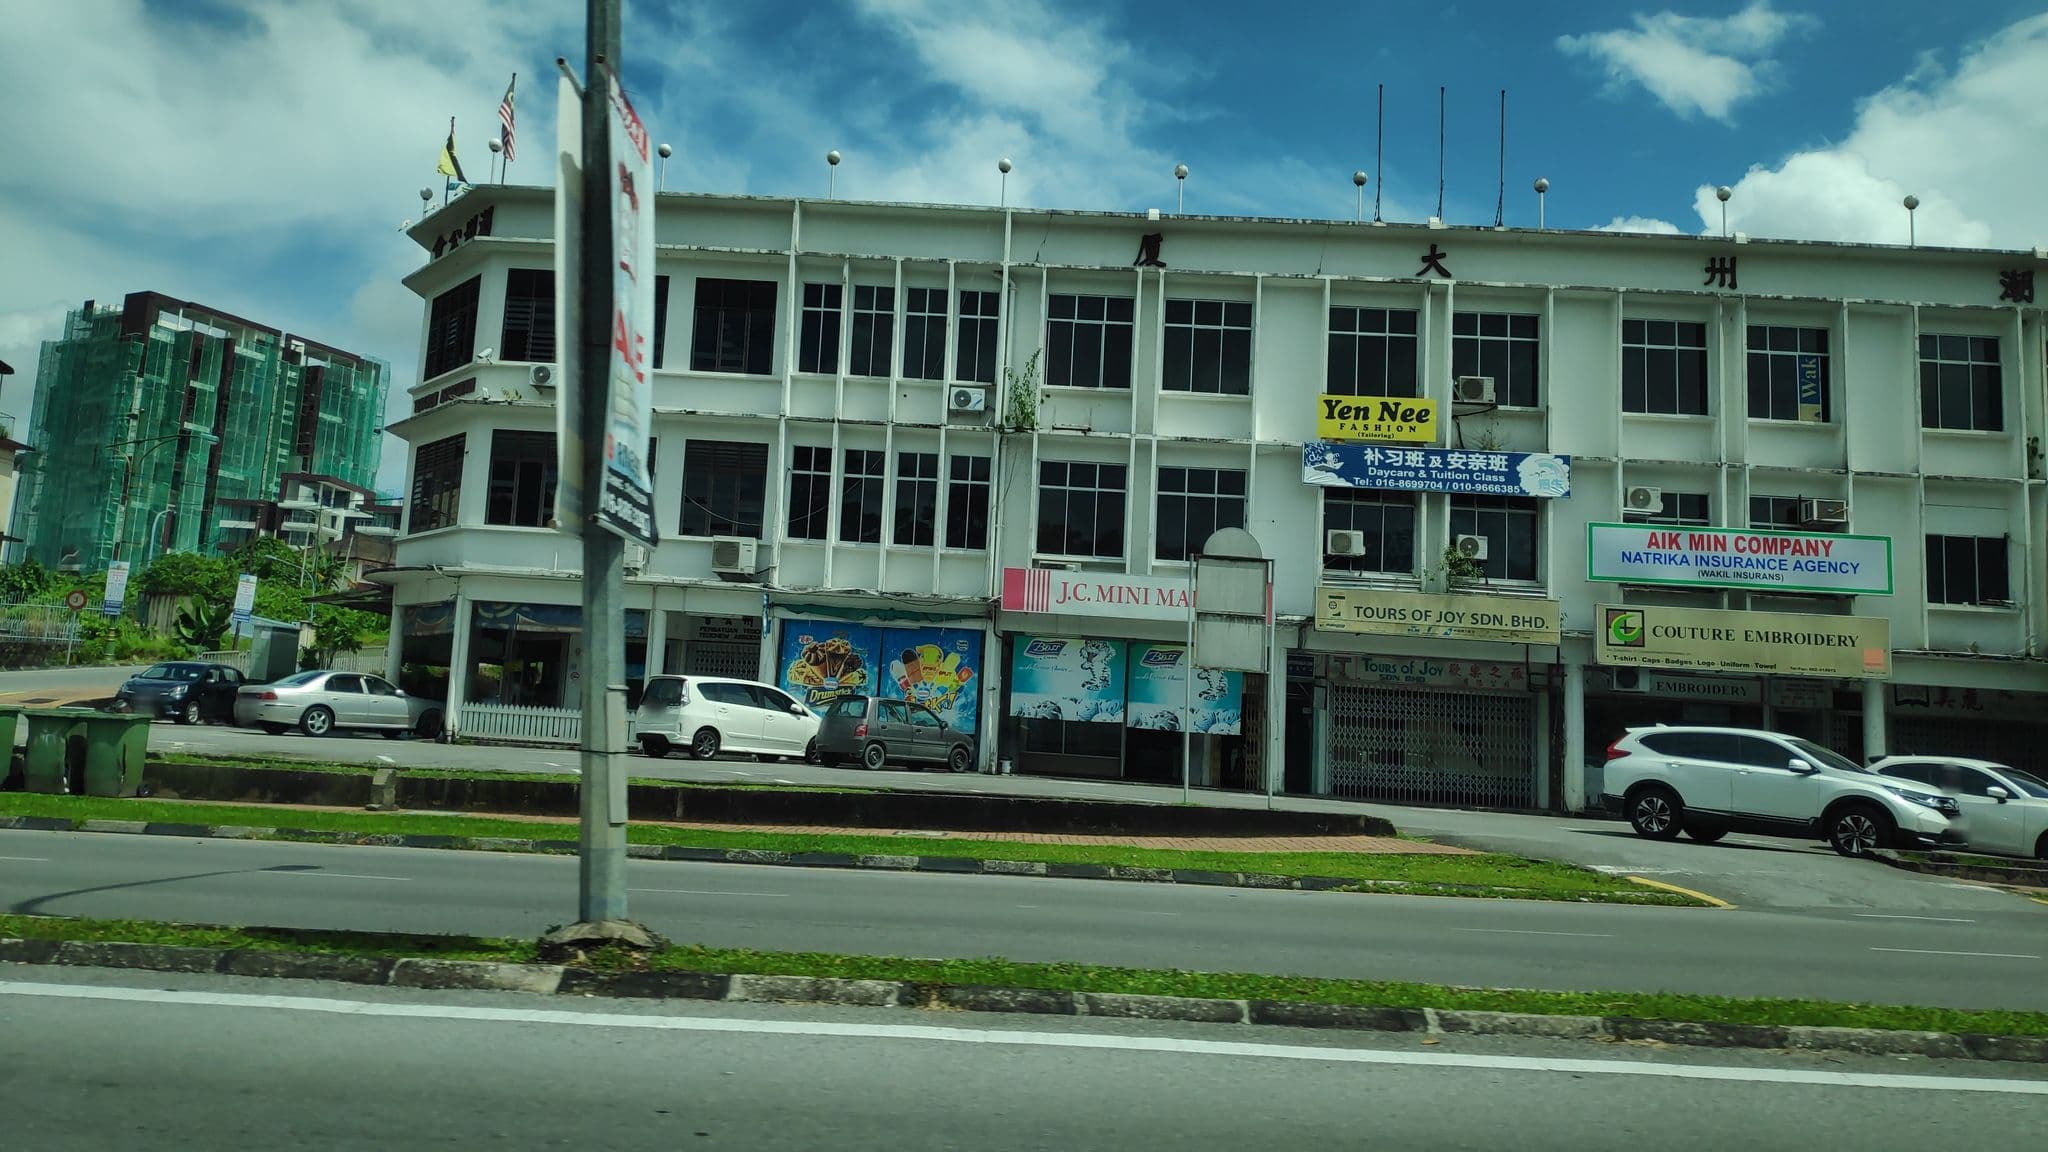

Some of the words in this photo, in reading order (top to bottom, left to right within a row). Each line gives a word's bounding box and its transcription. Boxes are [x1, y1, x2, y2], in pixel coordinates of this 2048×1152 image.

[1323, 399, 1370, 420] Yen
[1377, 401, 1430, 423] Nee
[1339, 423, 1416, 433] FASHION
[1353, 477, 1373, 487] Tel:
[1375, 478, 1443, 490] 016-8699704
[1452, 481, 1520, 493] 010-9666385
[1368, 467, 1415, 479] Daycare
[1418, 469, 1427, 478] &
[1430, 469, 1470, 481] Tuition
[1472, 472, 1505, 482] Class
[1647, 531, 1682, 551] AIK
[1689, 533, 1727, 553] MIN
[1734, 535, 1834, 558] COMPANY
[1621, 551, 1690, 567] NATRIKA
[1695, 554, 1788, 571] INSURANCE
[1792, 559, 1860, 575] AGENCY
[1697, 570, 1730, 580] (WAKIL
[1733, 571, 1784, 582] INSURANS)
[1055, 581, 1091, 604] J.C.
[1096, 584, 1150, 605] MINI
[1354, 606, 1406, 621] TOURS
[1411, 609, 1432, 622] OF
[1436, 611, 1465, 624] JOY
[1470, 613, 1508, 627] SDN.
[1511, 615, 1549, 629] BHD.
[1652, 624, 1735, 642] COUTURE
[1744, 629, 1859, 648] EMBROIDERY
[1656, 681, 1747, 697] EMBROIDERY
